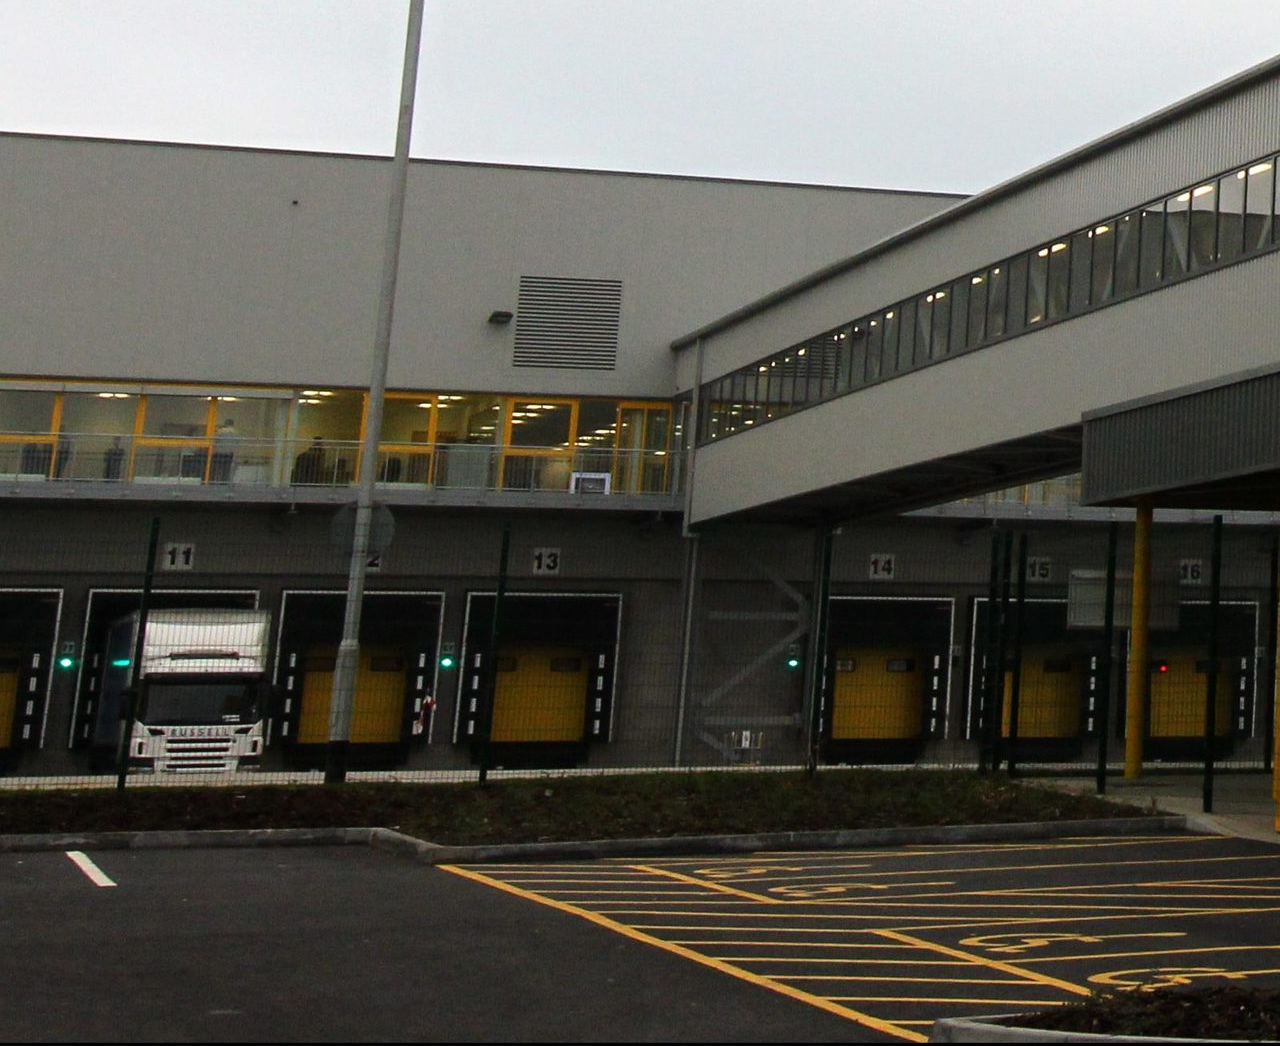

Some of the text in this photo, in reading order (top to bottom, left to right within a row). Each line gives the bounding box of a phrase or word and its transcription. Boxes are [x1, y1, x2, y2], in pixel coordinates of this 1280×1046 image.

[168, 547, 191, 565] 11
[535, 553, 558, 570] 13
[872, 558, 892, 574] 14
[1029, 560, 1049, 578] 15
[1181, 563, 1201, 579] 16
